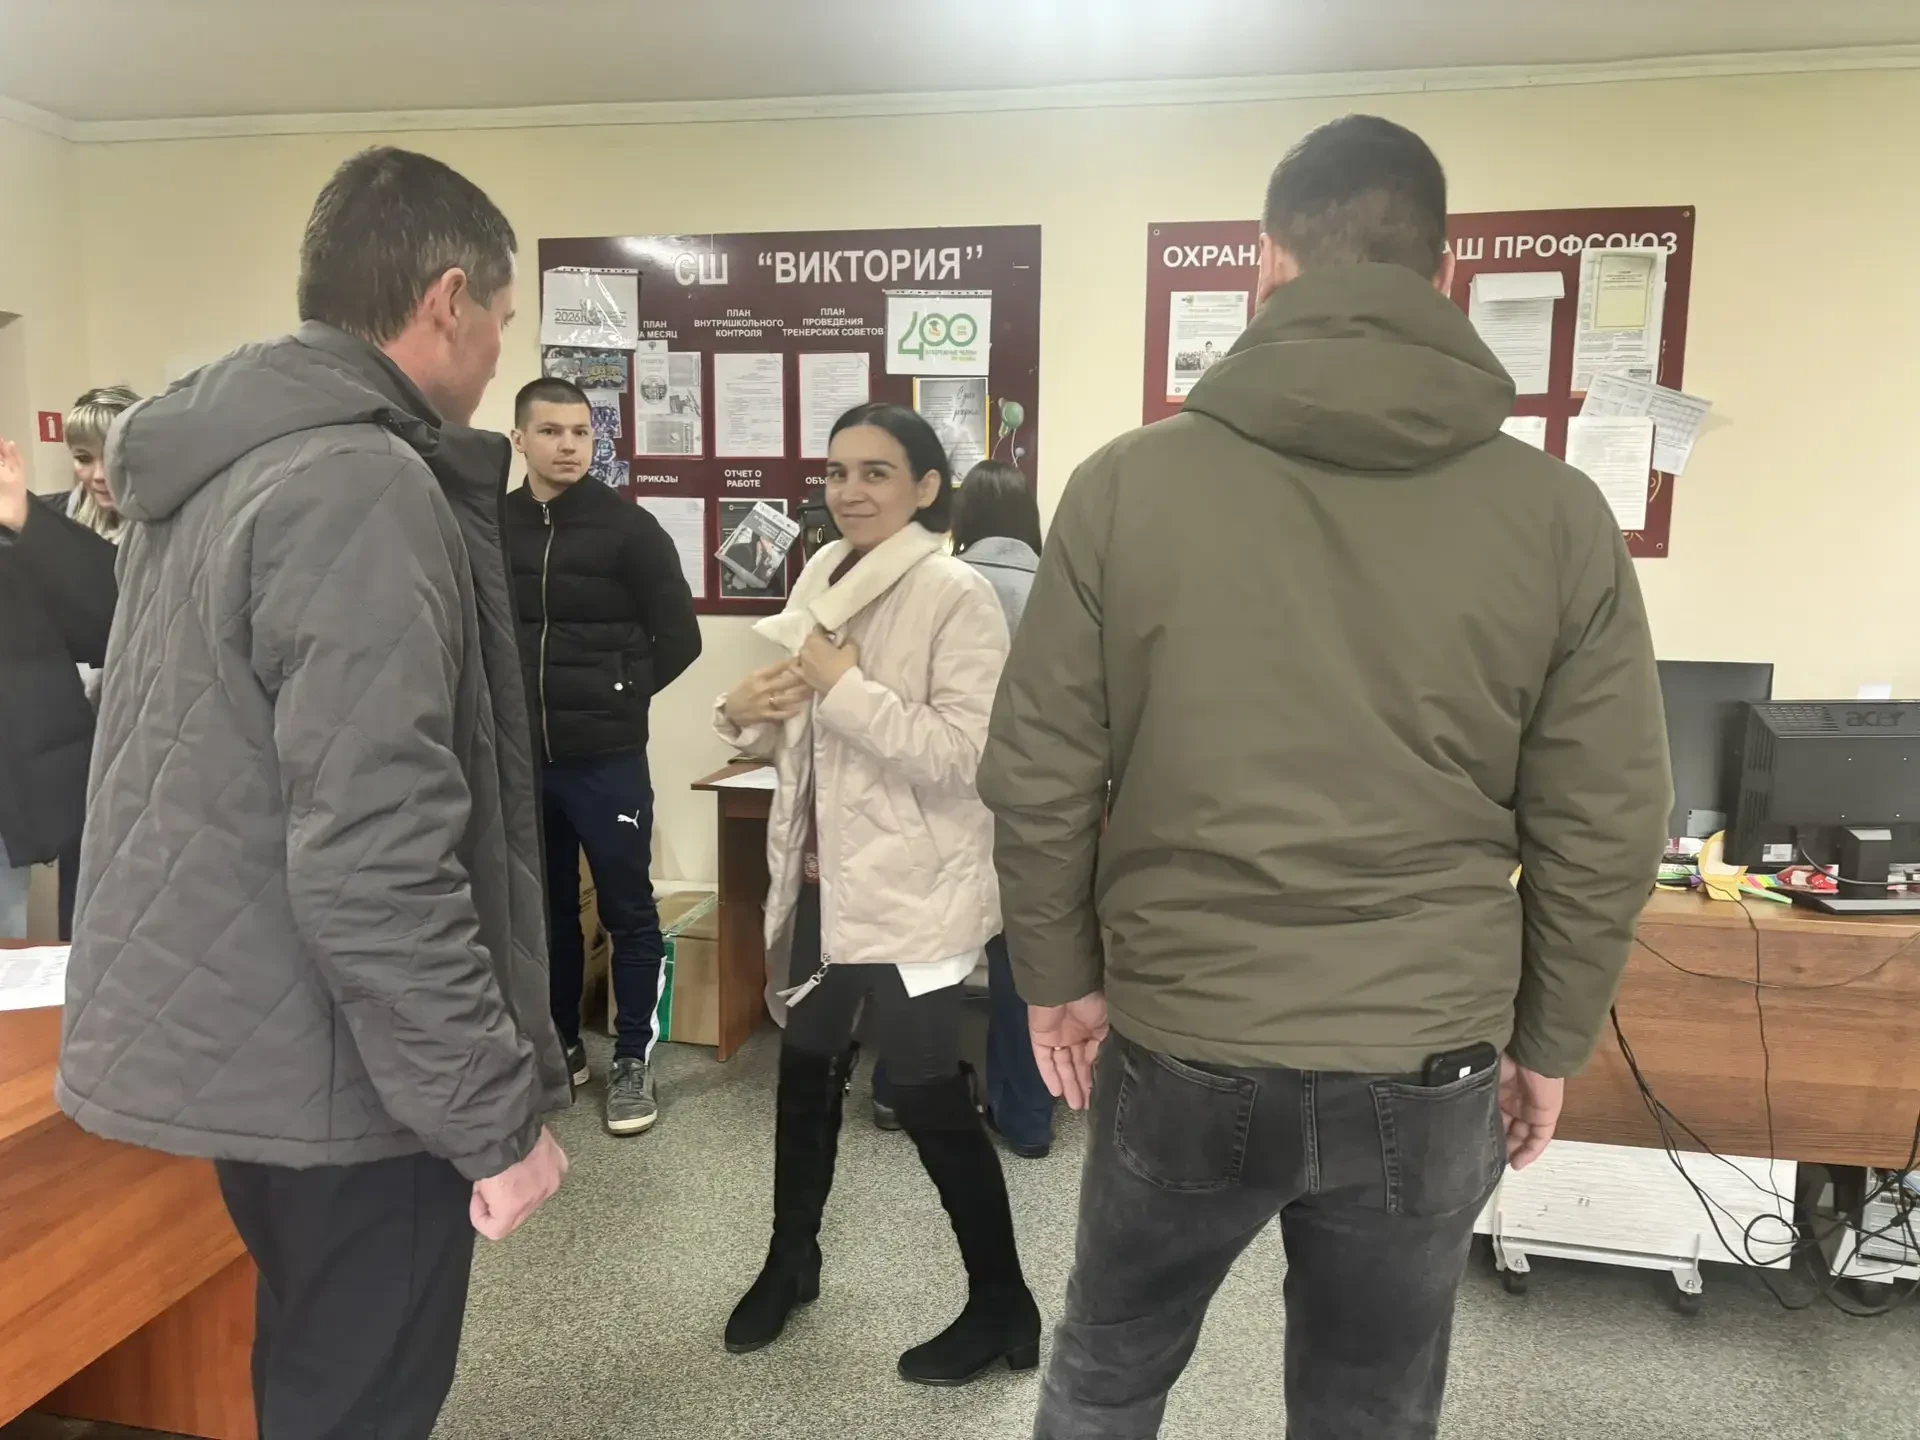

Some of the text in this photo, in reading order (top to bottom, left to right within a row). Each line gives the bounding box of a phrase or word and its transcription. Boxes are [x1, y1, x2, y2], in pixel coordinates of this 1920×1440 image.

[1493, 231, 1678, 259] ПРОФСОЮЗ
[1163, 244, 1261, 268] ОХРАН
[674, 252, 729, 286] СШ
[554, 310, 581, 323] 2026
[726, 309, 751, 318] ПЛАН
[820, 308, 846, 317] ПЛАН
[643, 320, 667, 329] ПЛАН
[694, 318, 784, 328] ВНУТРИШКОЛЬНОГО
[802, 317, 864, 327] ПРОВЕДЕНИЯ
[646, 330, 678, 339] МЕСЯЦ
[715, 328, 763, 338] КОНТРОЛЯ
[783, 326, 885, 337] ТРЕНЕРСКИХ СОВЕТОВ
[897, 310, 978, 361] 400
[724, 469, 762, 478] ОТЧЕТ О
[636, 474, 679, 484] ПРИКАЗЫ
[726, 479, 761, 488] РАБОТЕ
[1845, 709, 1906, 727] acer
